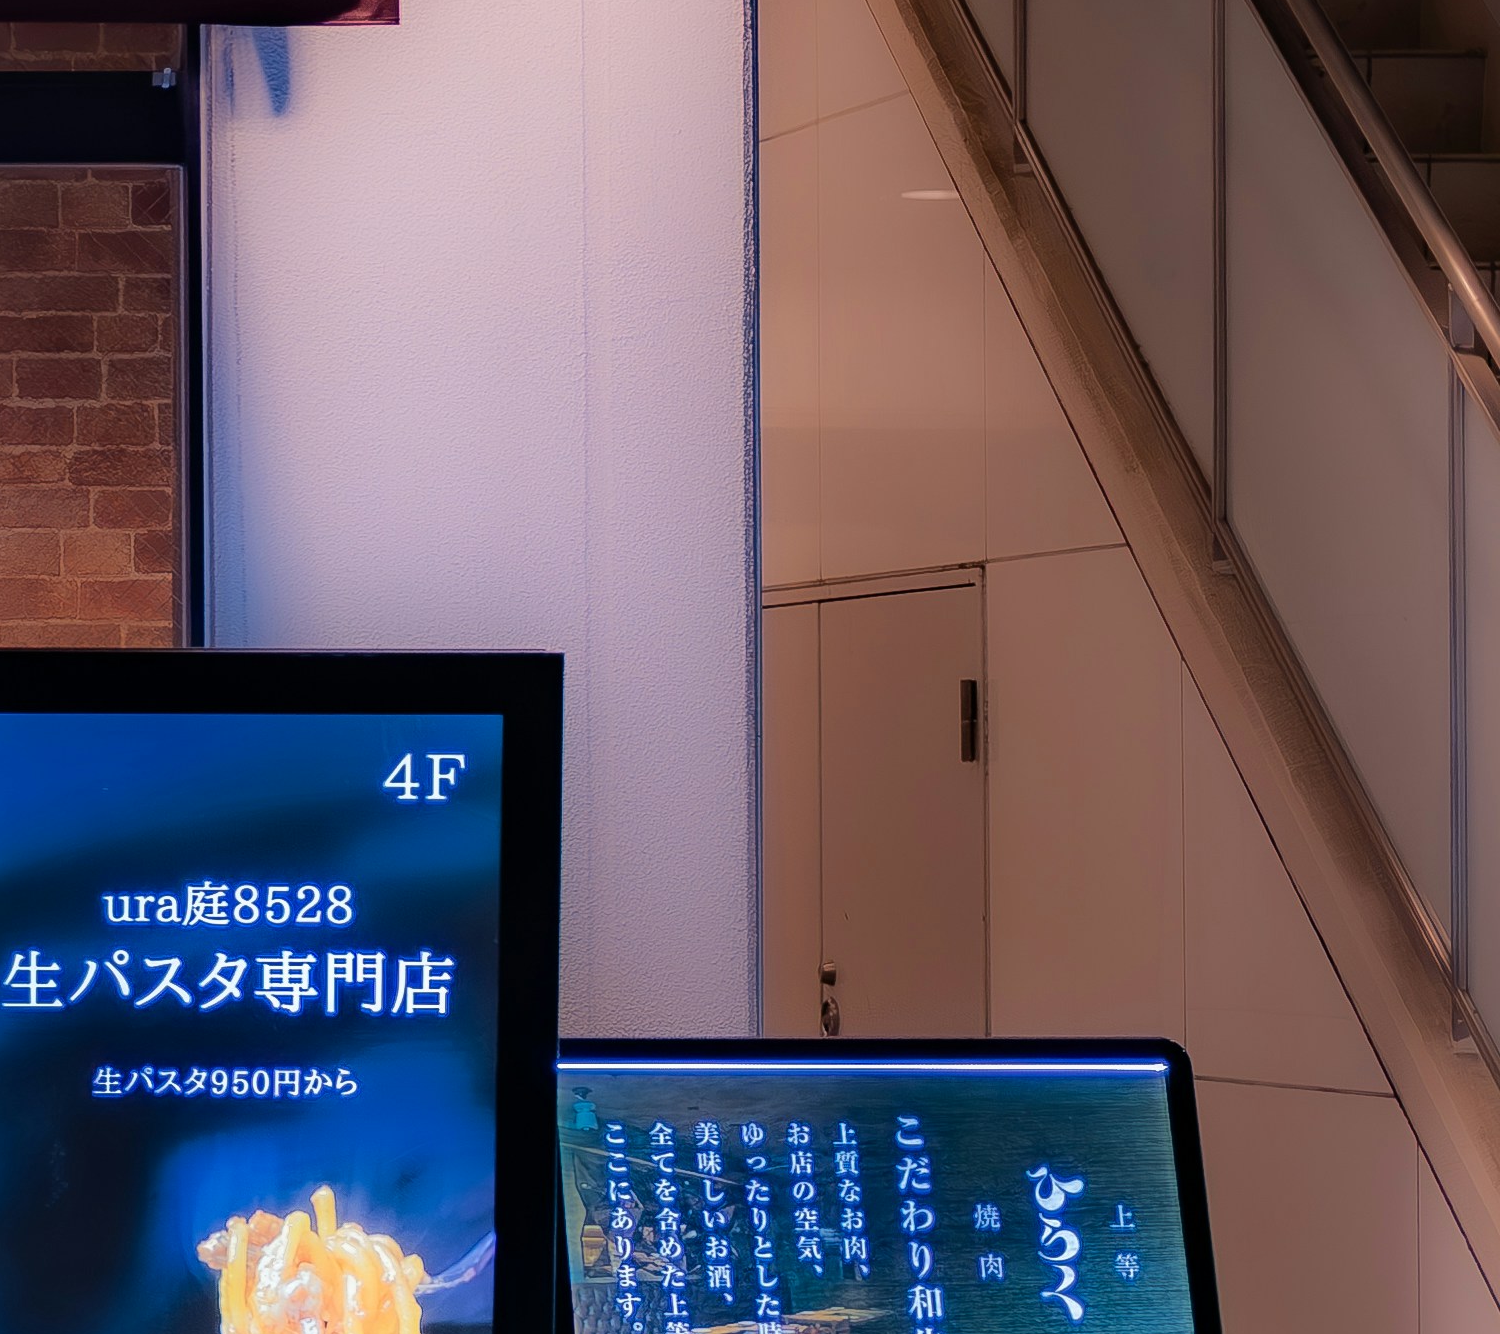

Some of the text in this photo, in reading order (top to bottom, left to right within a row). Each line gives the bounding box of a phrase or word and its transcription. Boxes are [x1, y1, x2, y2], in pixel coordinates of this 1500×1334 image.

[382, 753, 466, 801] 4F
[103, 881, 353, 926] ura庭8528
[2, 950, 454, 1016] 生パスタ専門店
[92, 1068, 359, 1098] 生パスタ950円から
[604, 1122, 645, 1333] ここにあります。
[974, 1204, 1004, 1280] 焼肉
[1026, 1165, 1085, 1322] ひらく
[1109, 1204, 1141, 1280] 上等
